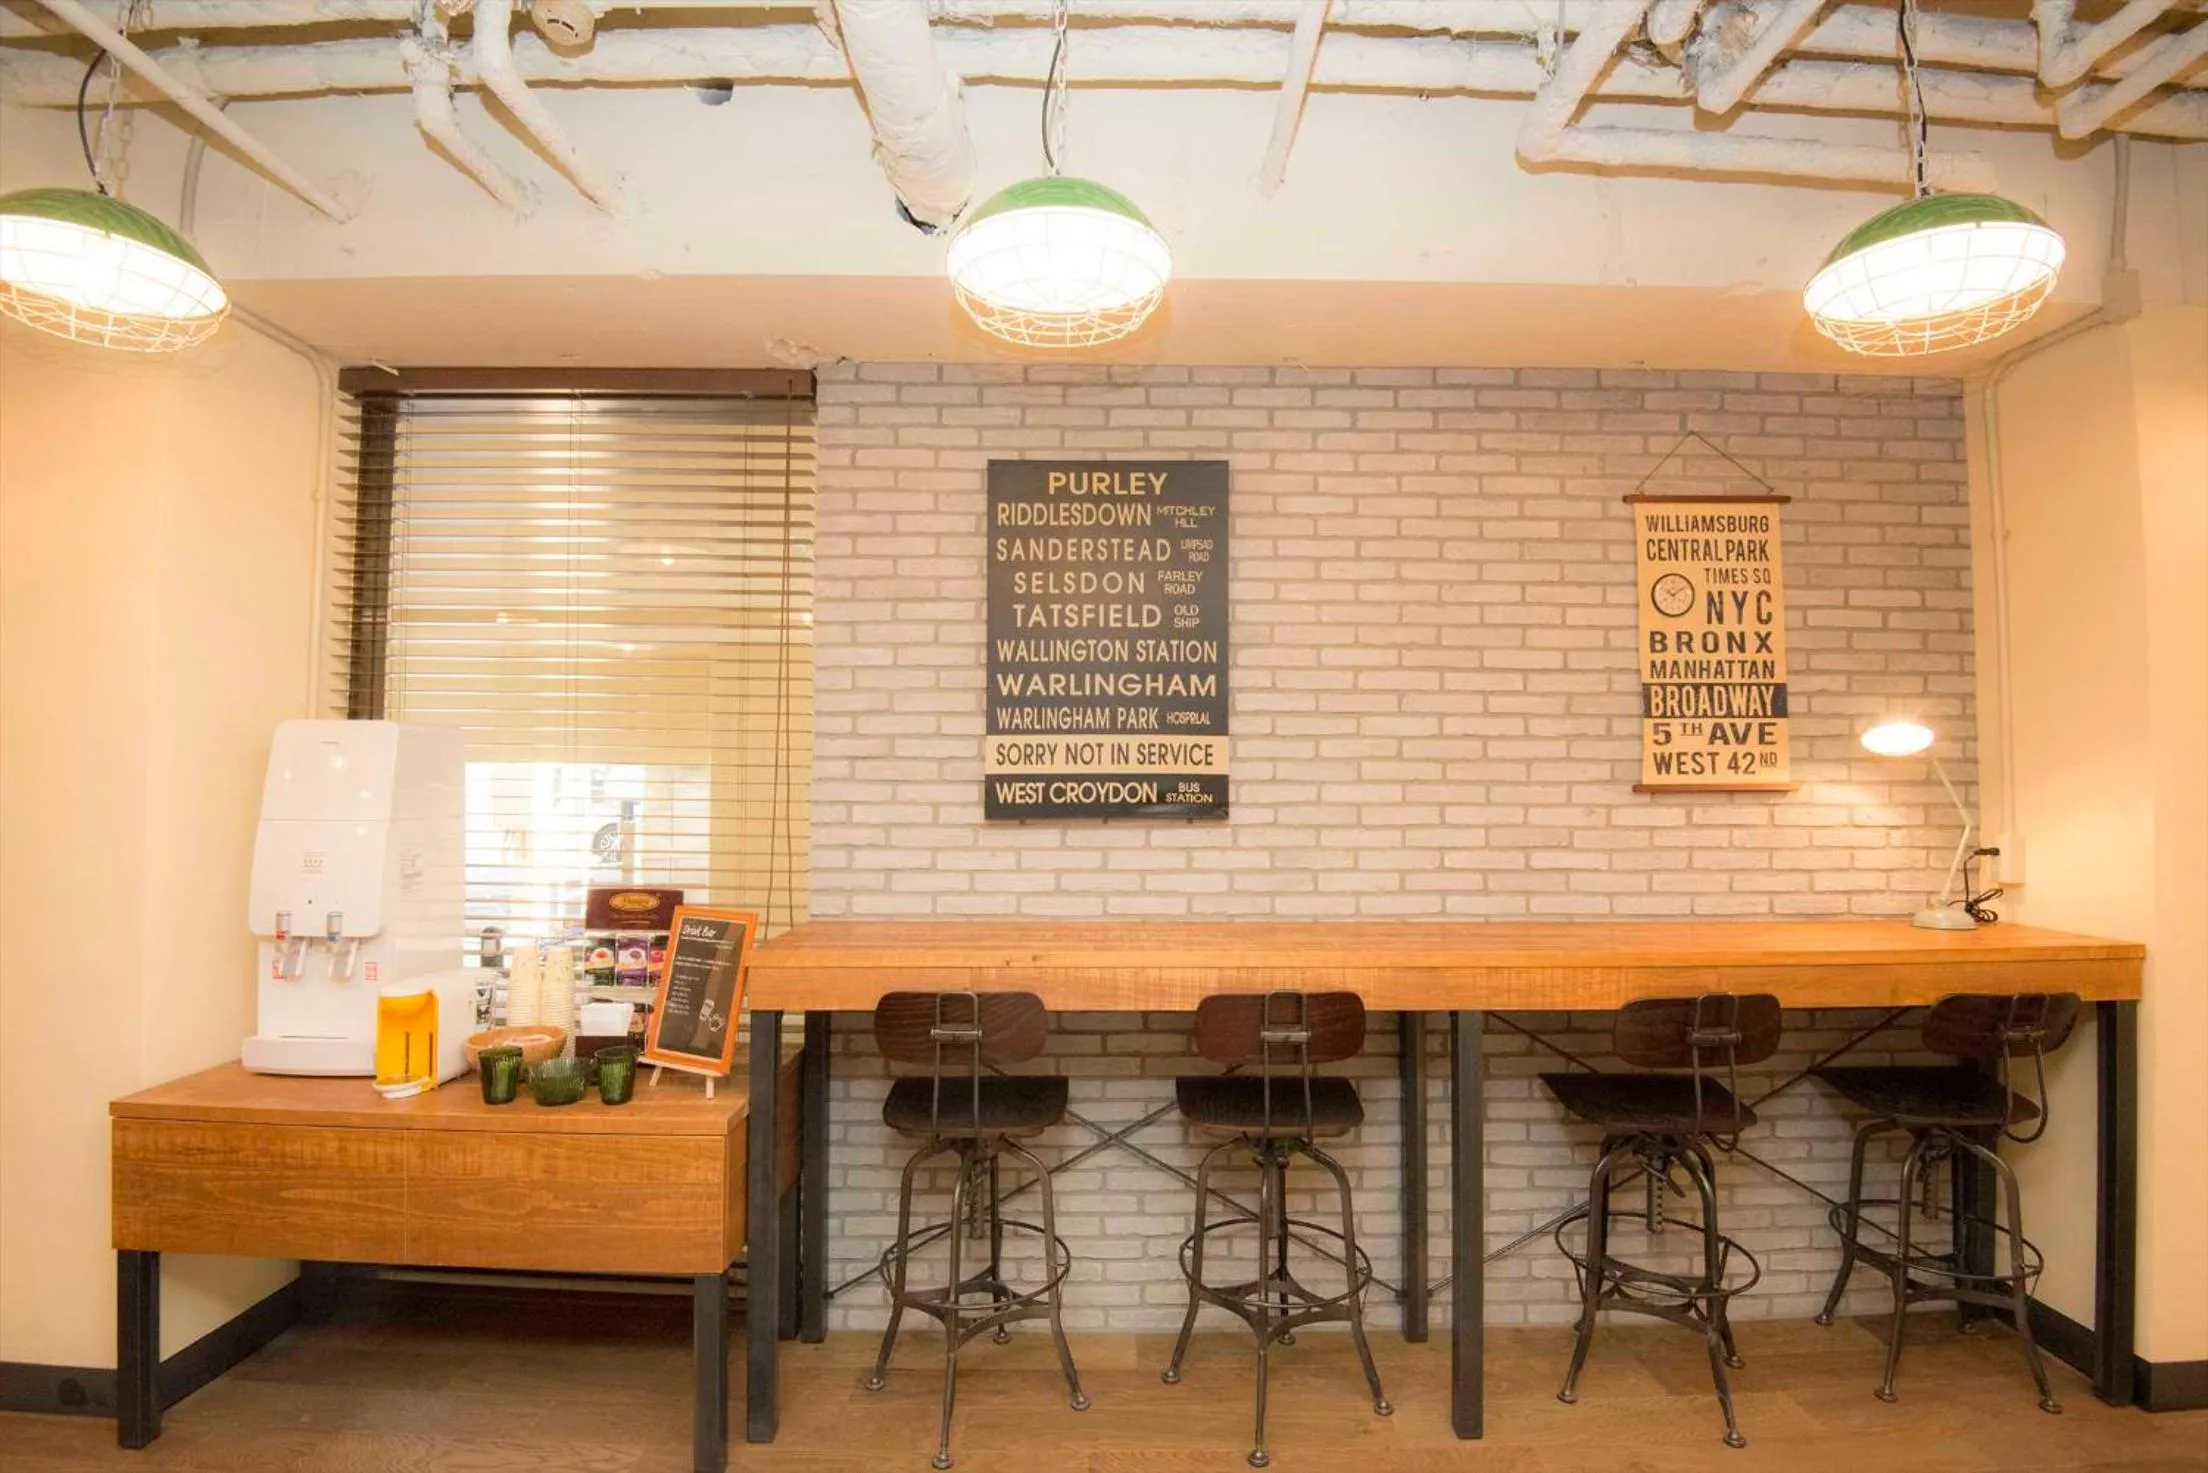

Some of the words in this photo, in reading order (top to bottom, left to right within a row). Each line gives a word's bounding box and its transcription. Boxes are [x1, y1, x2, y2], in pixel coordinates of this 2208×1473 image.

[1048, 472, 1169, 496] PURLEY
[996, 502, 1152, 527] RIDDLESDOWN
[1156, 505, 1216, 517] MITCHLEY
[1174, 517, 1198, 529] HILL
[1645, 515, 1770, 533] WILLIAMSBURG
[996, 538, 1172, 562] SANDERSTEAD
[1646, 538, 1723, 562] CENTRAL
[1726, 539, 1770, 562] PARK
[1013, 571, 1145, 595] SELSDON
[1157, 571, 1203, 583] FARLEY
[1703, 568, 1748, 584] TIMES
[1753, 568, 1771, 585] SQ
[1164, 583, 1196, 596] ROAD
[1012, 604, 1162, 628] TATSFIELD
[1173, 604, 1199, 616] OLD
[1706, 590, 1773, 625] NYC
[1173, 617, 1200, 628] SHIP
[996, 639, 1129, 663] WALLINGTON
[1135, 639, 1218, 664] STATION
[1649, 631, 1774, 654] BRONX
[1649, 660, 1775, 680] MANHATTAN
[996, 673, 1217, 697] WARLINGHAM
[1650, 685, 1775, 718] BROADWAY
[996, 707, 1110, 730] WARLINGHAM
[1117, 707, 1159, 730] PARK
[1707, 722, 1778, 746] AVE
[996, 742, 1058, 766] SORRY
[1065, 742, 1104, 766] NOT
[1111, 743, 1129, 766] IN
[1136, 742, 1214, 766] SERVICE
[1653, 751, 1720, 775] WEST
[1727, 751, 1778, 775] 42ND
[996, 781, 1045, 805] WEST
[1050, 781, 1158, 805] CROYDON
[1166, 793, 1213, 804] STATION
[1178, 782, 1200, 793] BUS
[682, 924, 702, 937] Drink
